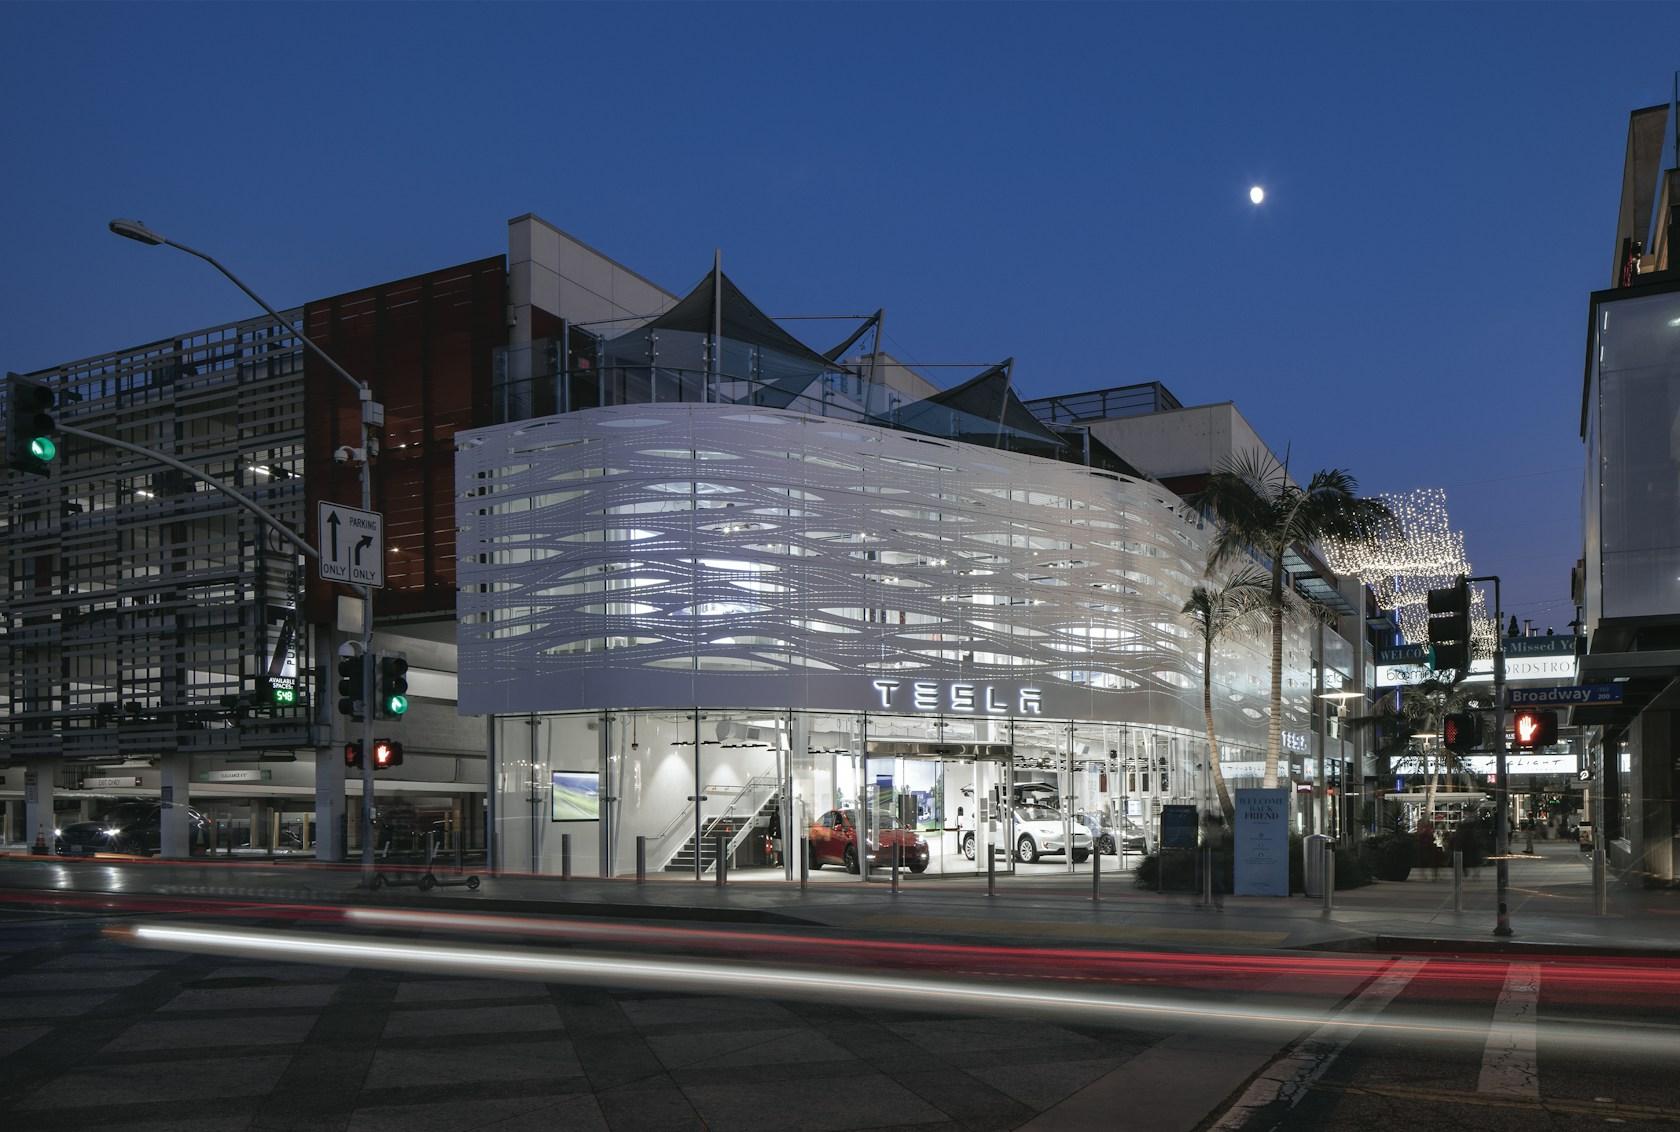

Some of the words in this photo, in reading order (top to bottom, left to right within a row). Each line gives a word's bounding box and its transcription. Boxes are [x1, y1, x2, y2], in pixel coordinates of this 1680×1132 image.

[349, 517, 377, 531] PARKING
[323, 563, 346, 577] ONLY
[353, 568, 376, 581] ONLY
[1380, 649, 1422, 660] WELCO
[1510, 640, 1554, 653] Missed
[268, 677, 296, 686] AVAILABLE
[276, 690, 293, 702] 548
[873, 681, 1042, 713] TESLA
[1512, 689, 1591, 702] Broadway
[1244, 811, 1279, 820] FRIEND
